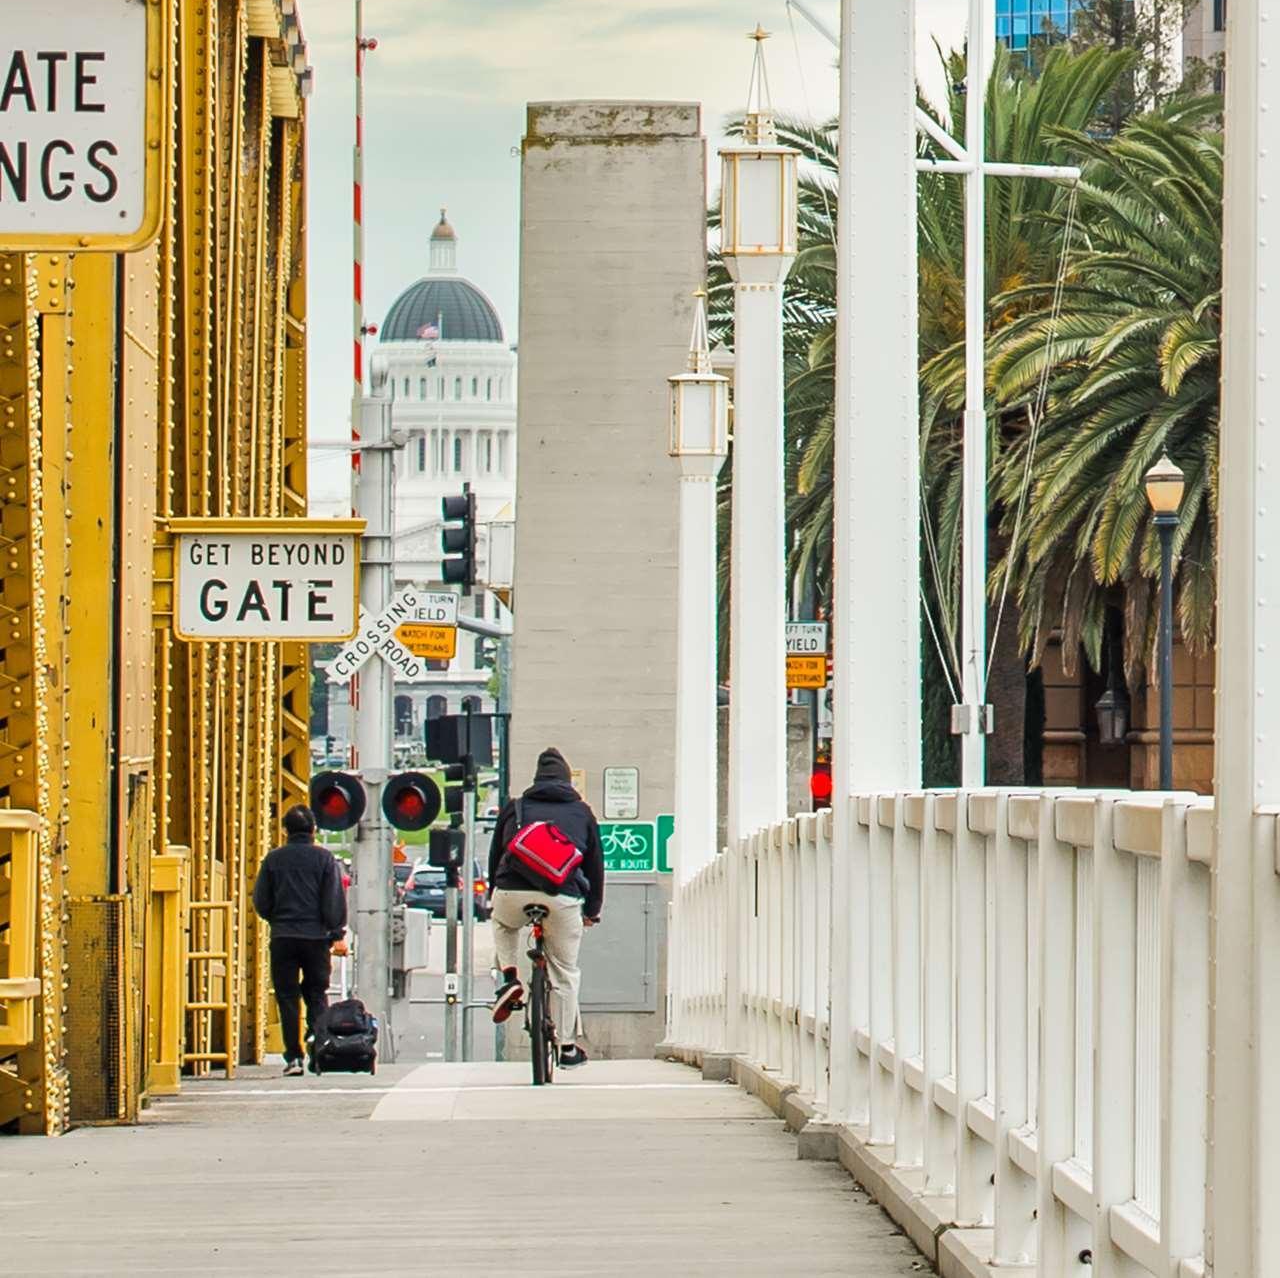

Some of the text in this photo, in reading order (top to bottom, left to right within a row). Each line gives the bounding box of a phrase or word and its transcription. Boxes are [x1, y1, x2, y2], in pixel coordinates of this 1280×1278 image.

[0, 49, 106, 113] ATE
[190, 543, 345, 565] GET BEYOND
[200, 578, 334, 622] GATE
[411, 607, 446, 620] IELD
[429, 595, 454, 604] TURN
[335, 593, 417, 676] CROSSING
[381, 639, 420, 678] ROAD
